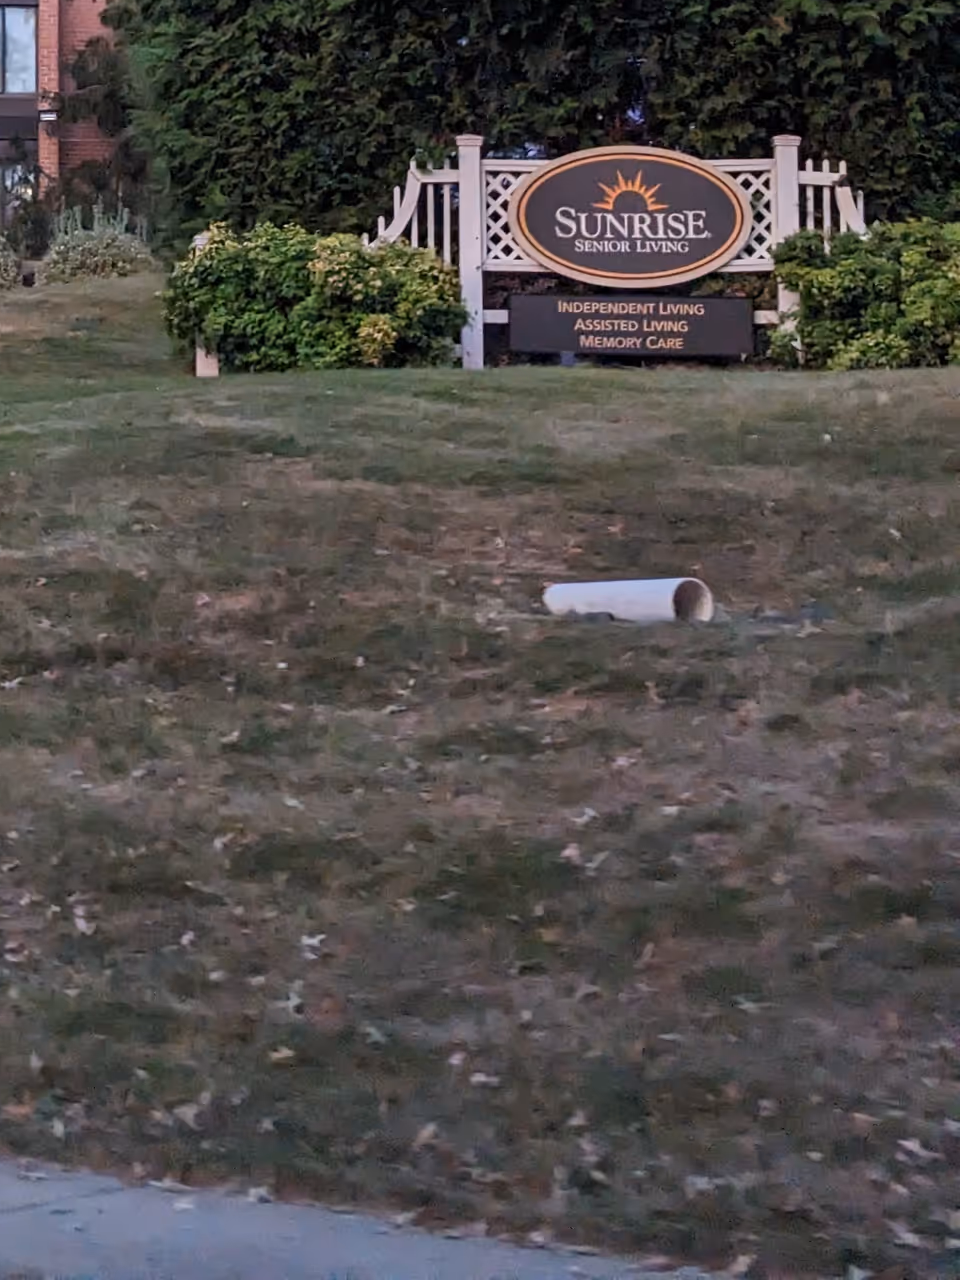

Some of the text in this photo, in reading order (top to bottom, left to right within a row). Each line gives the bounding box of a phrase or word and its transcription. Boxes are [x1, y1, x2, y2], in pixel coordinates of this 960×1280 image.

[555, 206, 709, 239] SUNRISE
[574, 239, 689, 253] SENIOR LIVING
[557, 300, 705, 316] INDEPENDENT LIVING
[574, 318, 689, 333] ASSISTED LIVING
[579, 335, 685, 350] MEMORY CARE
